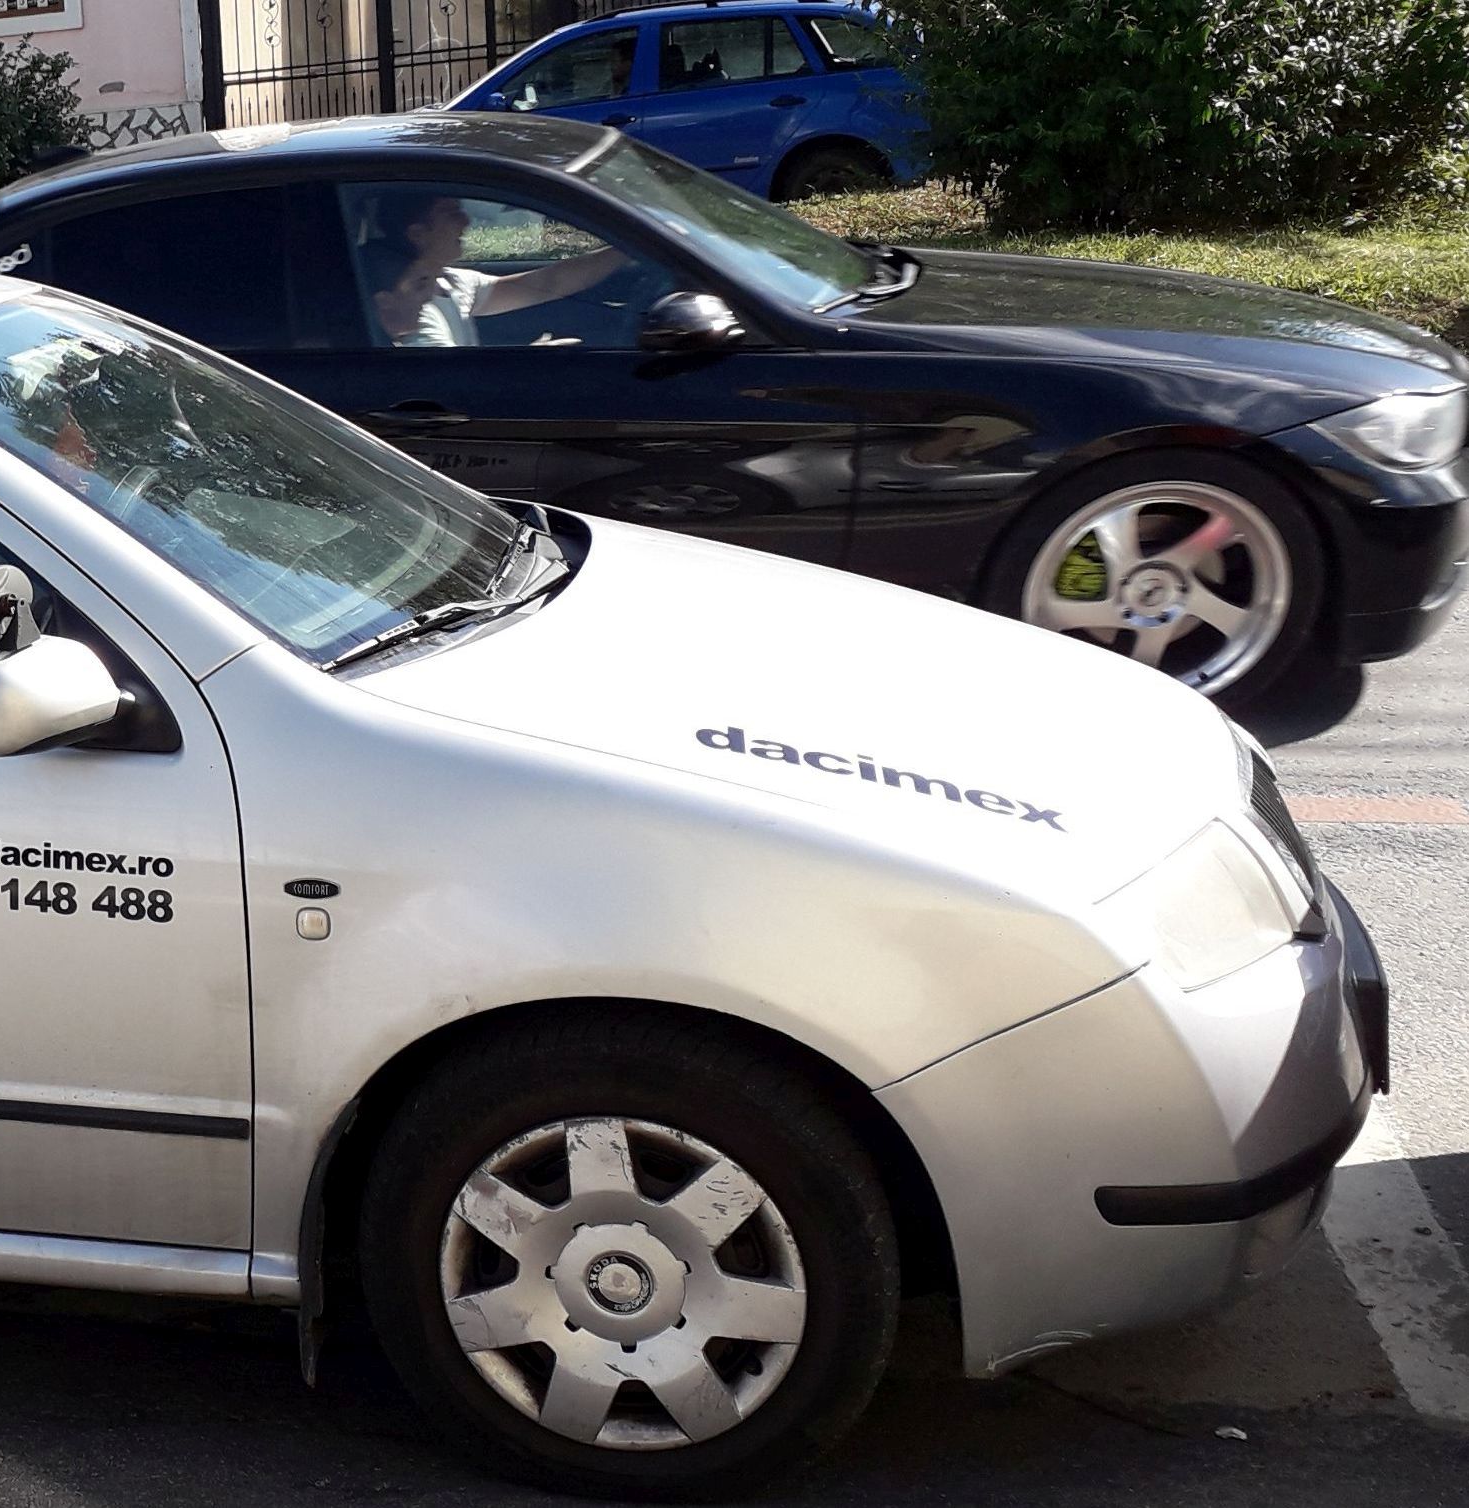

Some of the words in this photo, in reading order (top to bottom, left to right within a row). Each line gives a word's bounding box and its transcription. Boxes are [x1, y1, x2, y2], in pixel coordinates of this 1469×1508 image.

[695, 726, 1069, 834] dacimex
[0, 878, 78, 915] 148
[91, 885, 174, 923] 488
